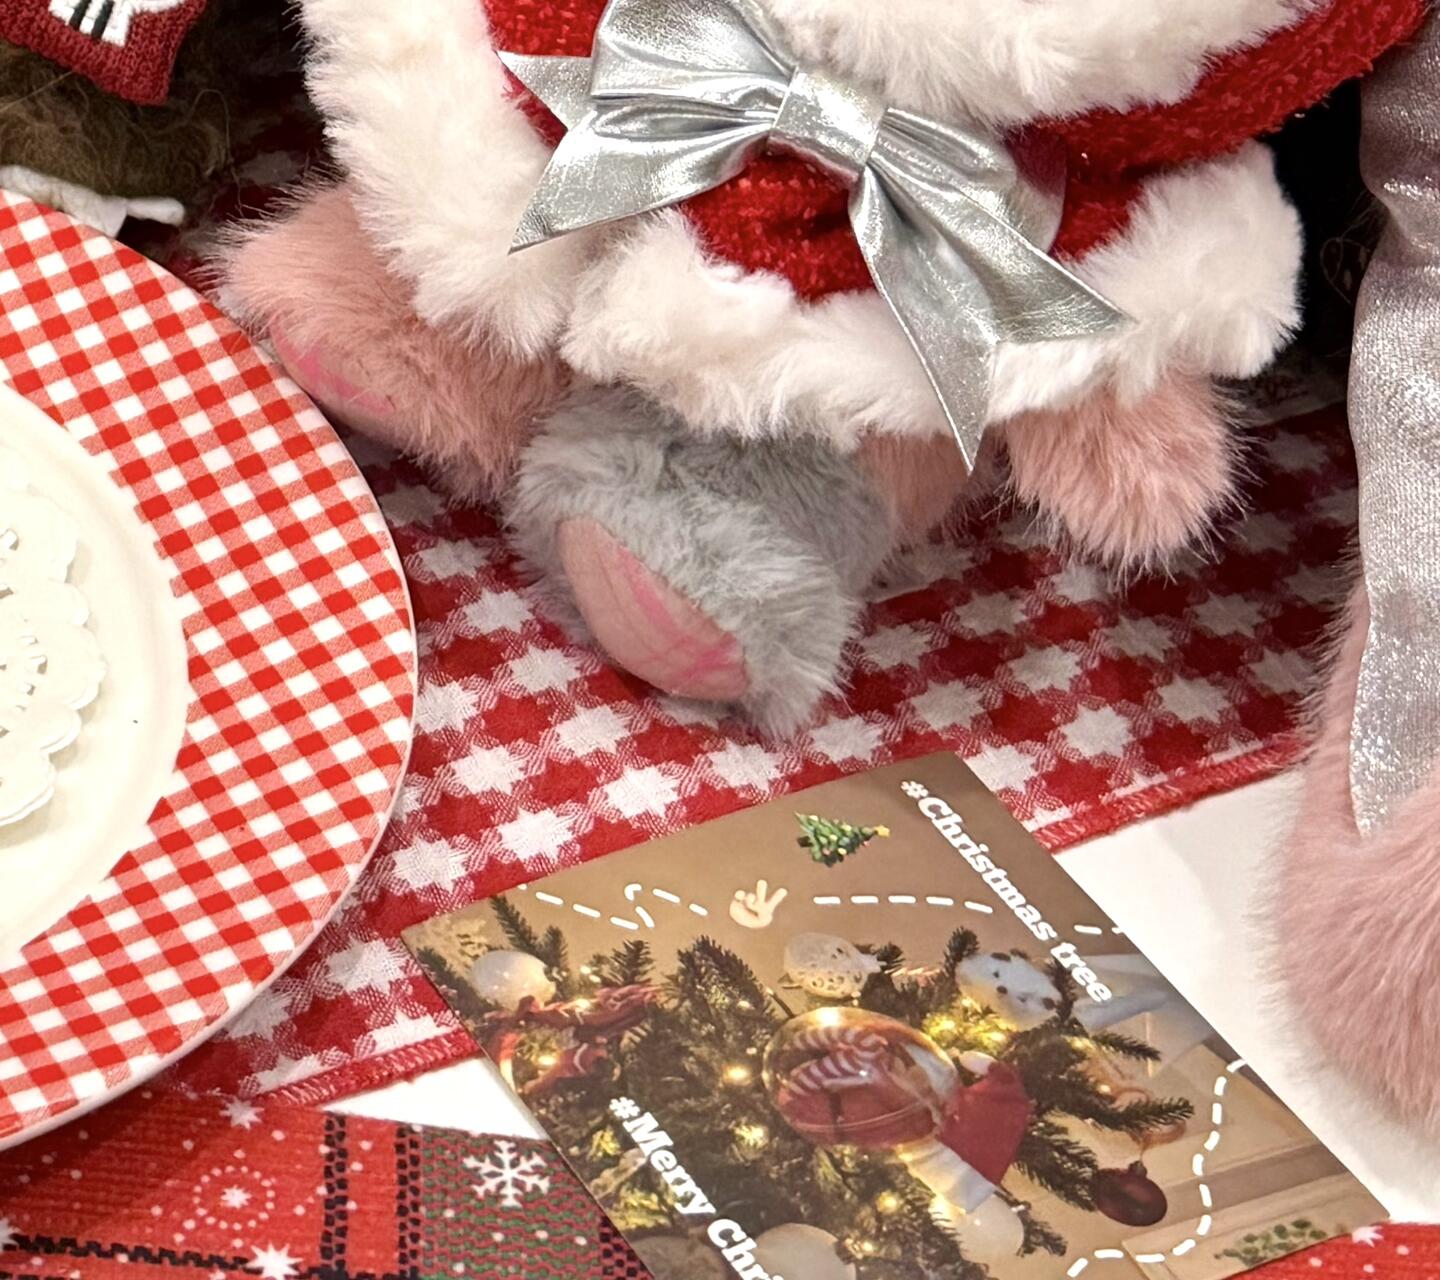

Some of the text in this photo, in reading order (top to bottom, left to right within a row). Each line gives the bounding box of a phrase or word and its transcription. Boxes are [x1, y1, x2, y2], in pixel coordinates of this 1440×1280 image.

[900, 780, 1113, 1003] #Christmas tree
[608, 1096, 717, 1215] #Merry
